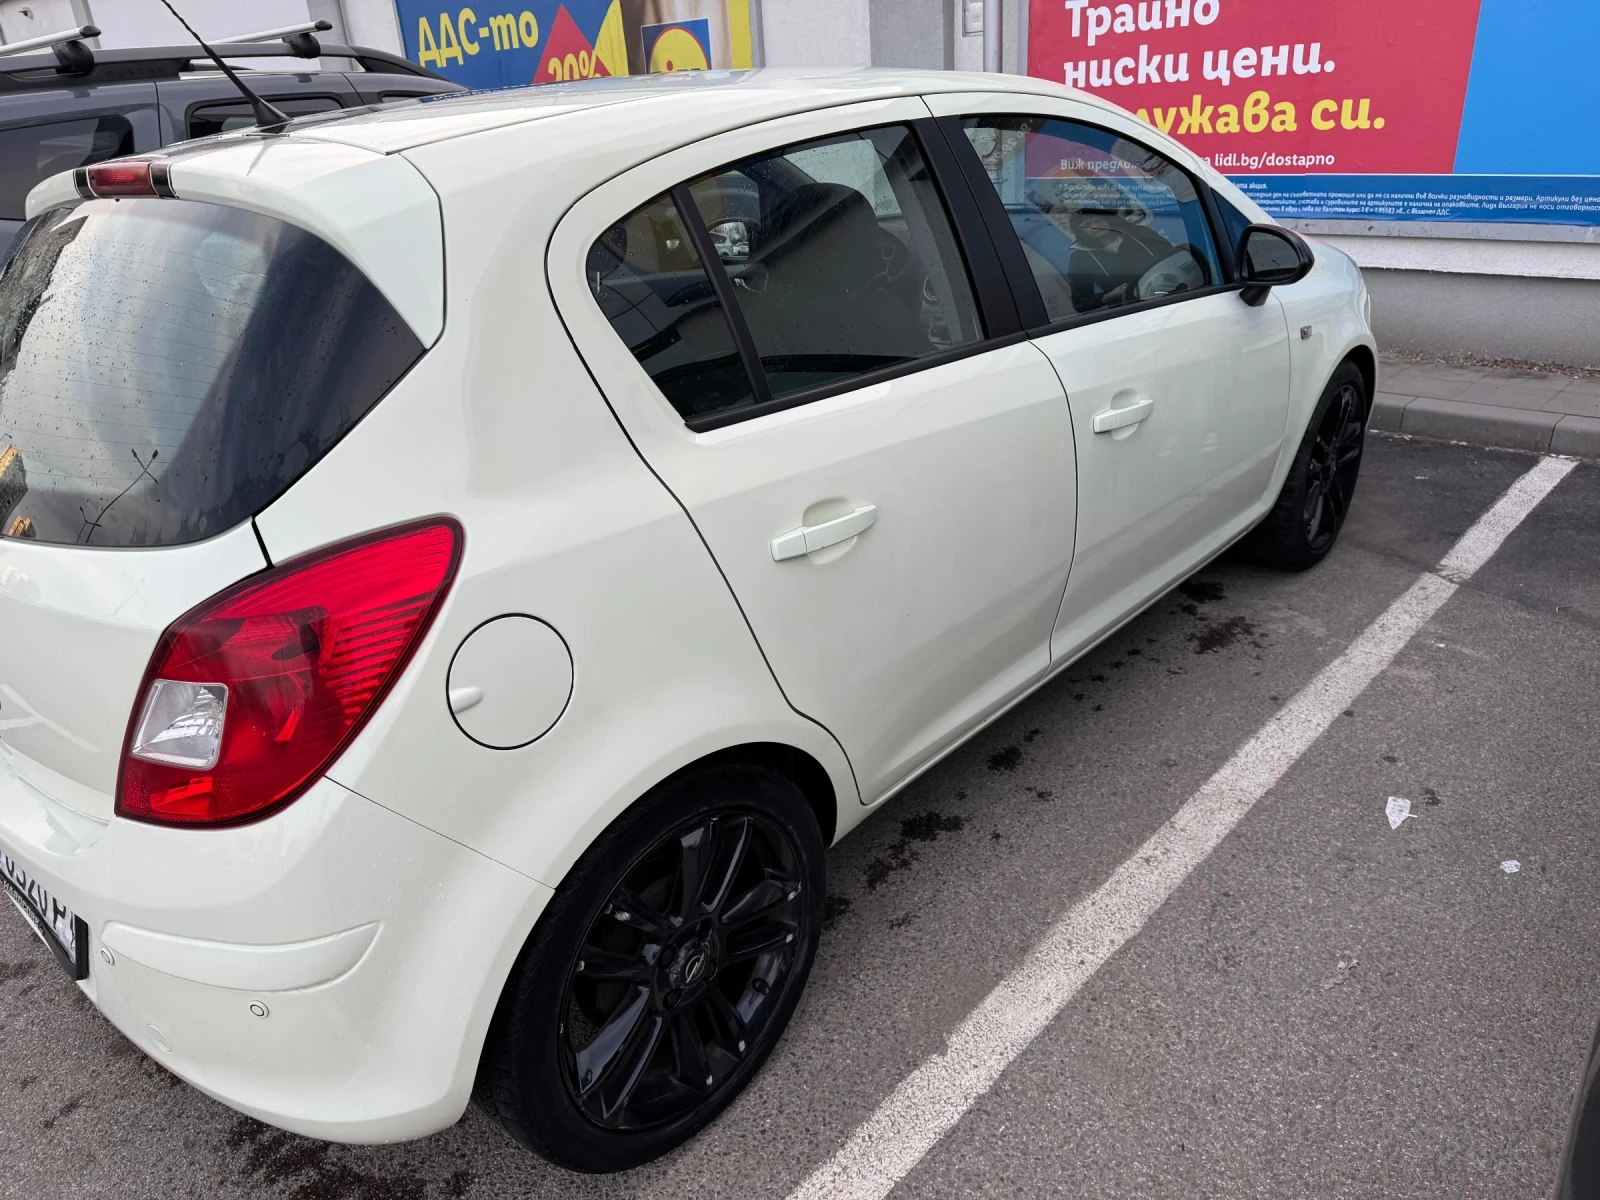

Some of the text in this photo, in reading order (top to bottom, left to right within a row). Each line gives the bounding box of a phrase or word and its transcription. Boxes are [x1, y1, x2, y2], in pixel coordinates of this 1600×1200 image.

[1063, 42, 1336, 89] ниски цени.
[1311, 98, 1386, 133] си.
[1060, 158, 1084, 170] Виж
[1214, 151, 1335, 169] lidl.bg/dostapno
[1536, 195, 1569, 203] Артикули
[1570, 195, 1583, 204] без
